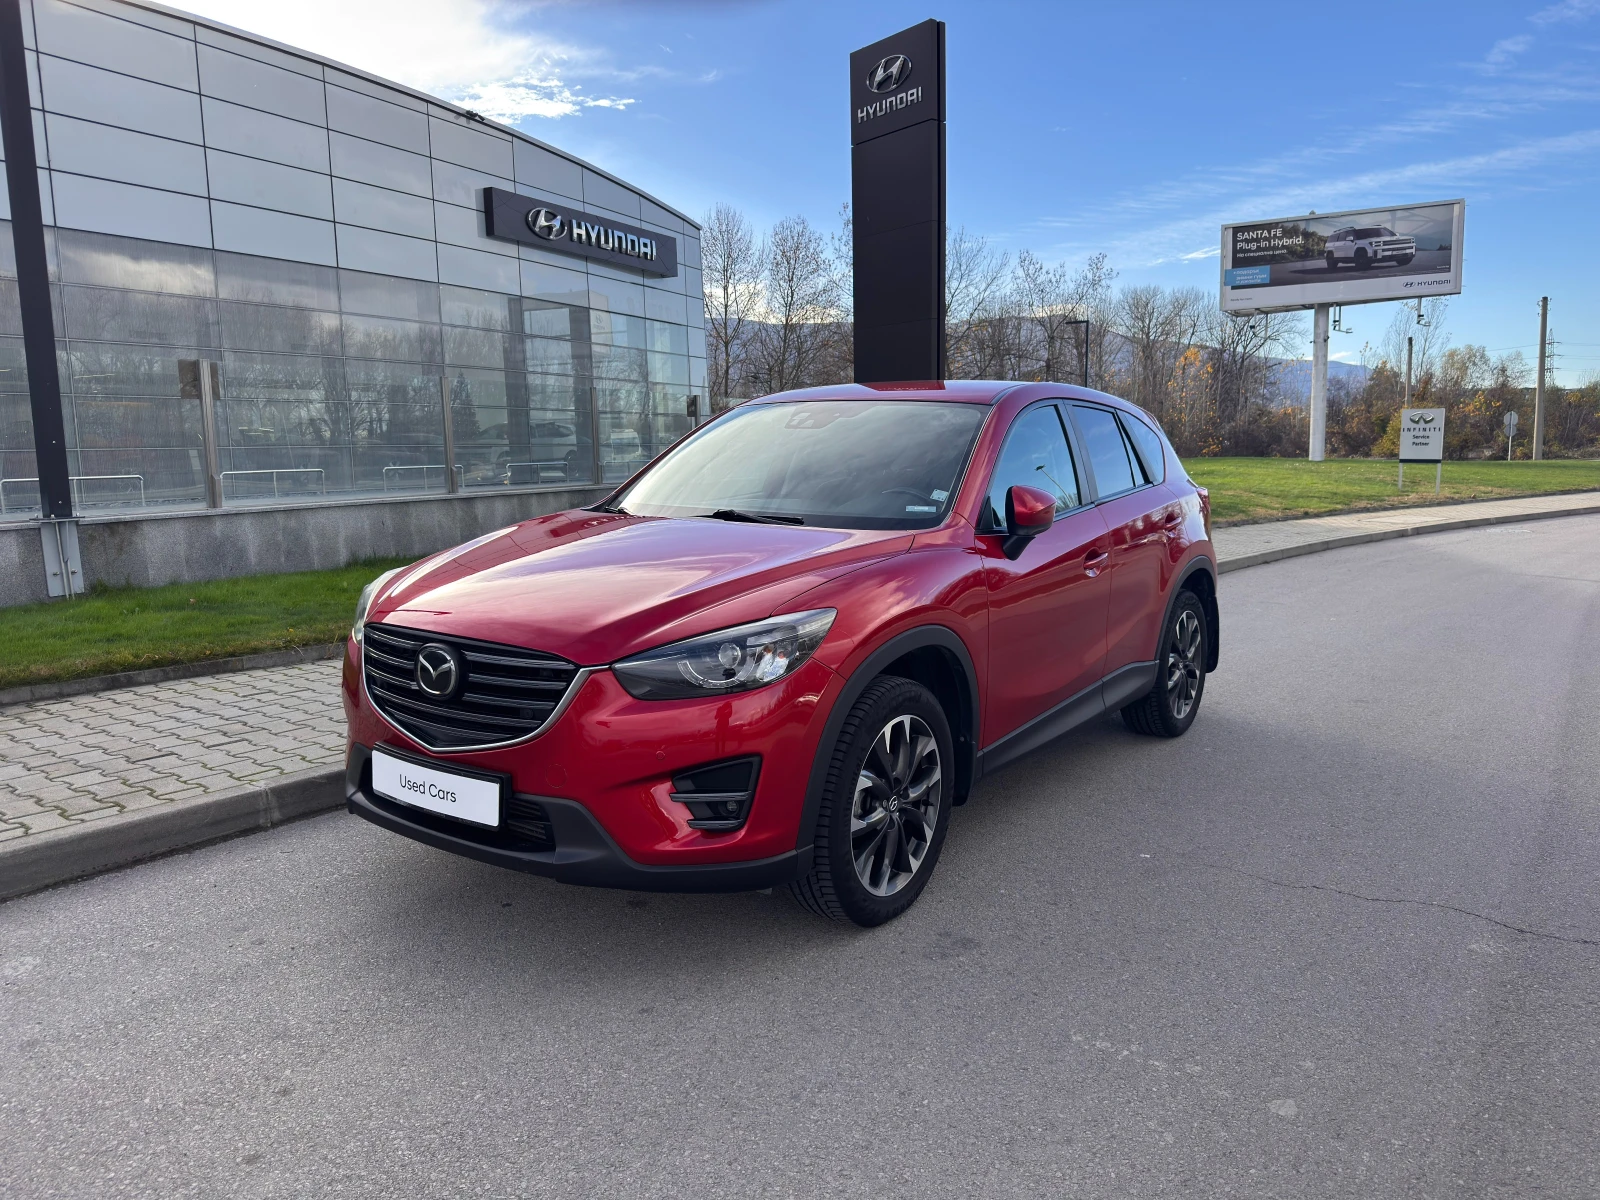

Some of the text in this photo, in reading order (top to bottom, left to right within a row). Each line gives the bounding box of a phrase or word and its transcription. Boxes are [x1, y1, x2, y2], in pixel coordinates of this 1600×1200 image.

[857, 86, 922, 123] HYUNDAI
[572, 219, 657, 261] HYUNDAI
[1236, 228, 1283, 241] SANTA FE
[1236, 236, 1305, 250] Plug-in Hybrid.
[1417, 279, 1451, 287] HYUNDAI
[399, 773, 426, 795] Used
[428, 783, 457, 803] Cars
